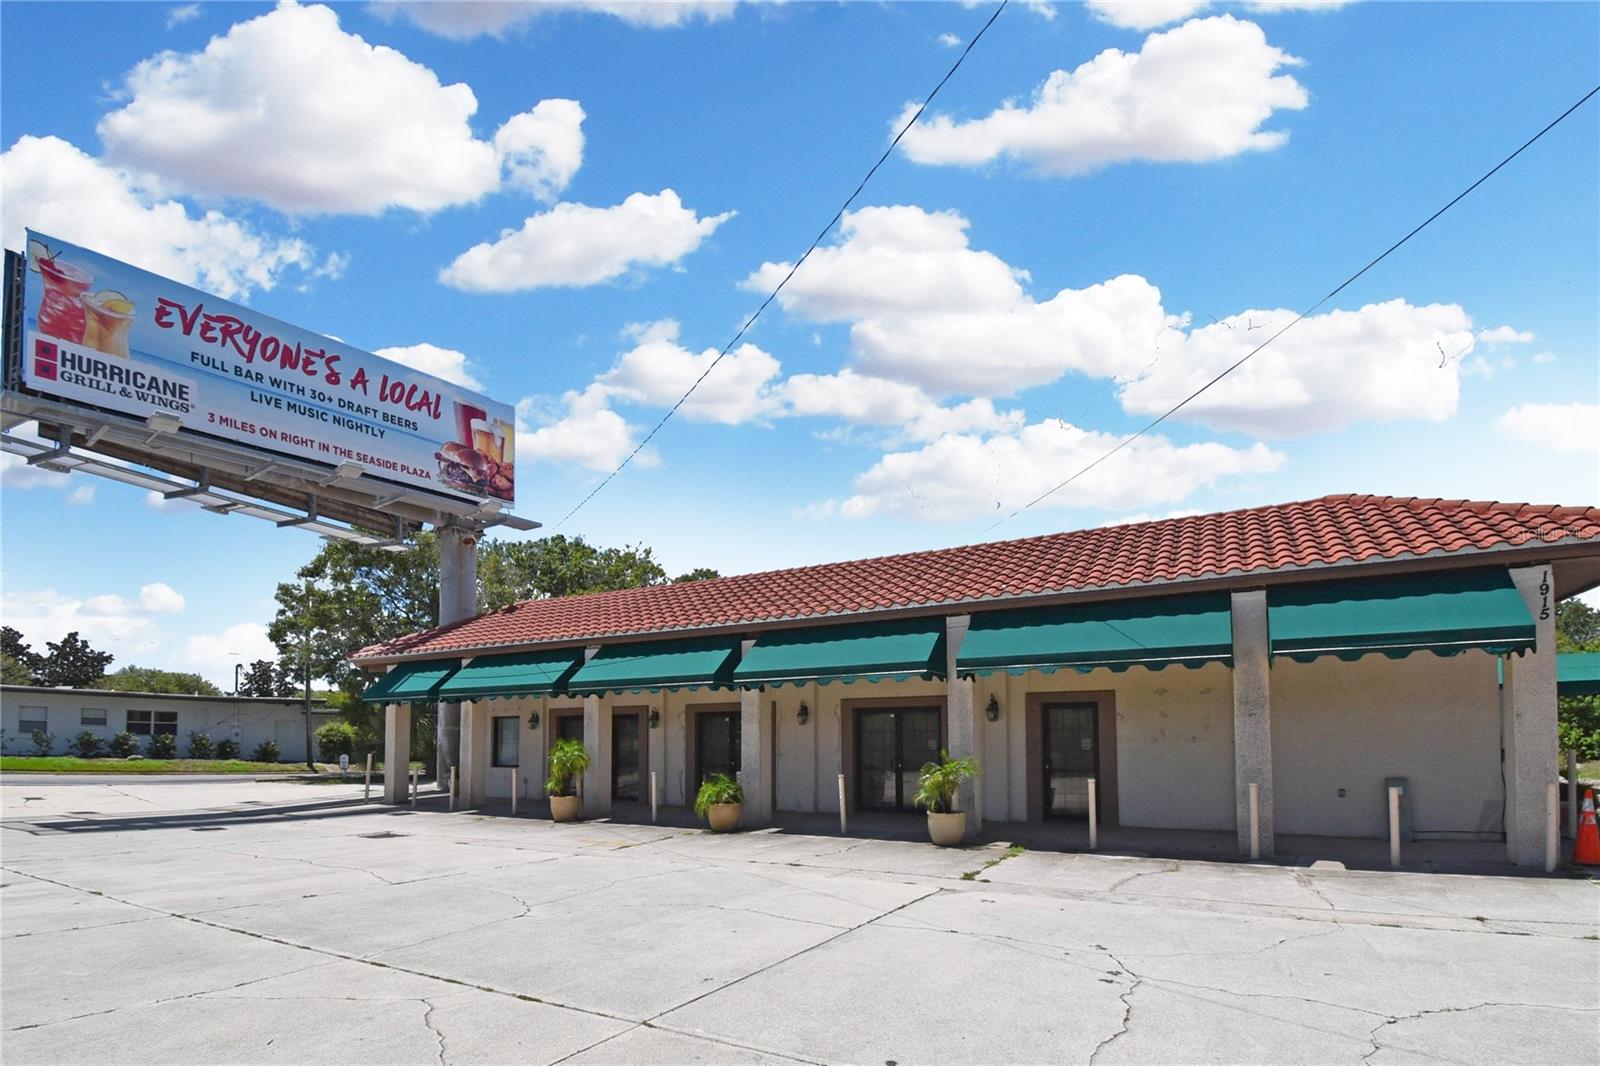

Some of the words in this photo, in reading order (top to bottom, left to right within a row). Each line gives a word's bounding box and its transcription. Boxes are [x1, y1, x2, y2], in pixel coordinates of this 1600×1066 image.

[60, 350, 190, 402] HURRICANE
[60, 370, 116, 396] GRILL
[119, 386, 133, 399] &
[190, 351, 229, 373] FULL
[234, 365, 264, 384] BAR
[269, 375, 306, 397] WITH
[309, 388, 334, 404] 30+
[337, 397, 379, 420] DRAFT
[382, 412, 419, 432] BEERS
[350, 367, 370, 396] A
[378, 374, 443, 420] LOCAL
[250, 390, 283, 410] LIVE
[286, 401, 329, 423] MUSIC
[332, 415, 386, 440] NIGHTLY
[207, 411, 216, 424] 3
[218, 415, 257, 434] MILES
[259, 426, 278, 440] ON
[280, 432, 316, 449] RIGHT
[318, 441, 330, 454] IN
[332, 445, 354, 461] THE
[355, 451, 399, 473] SEASIDE
[400, 464, 432, 480] PLAZA
[1539, 570, 1550, 620] 1915
